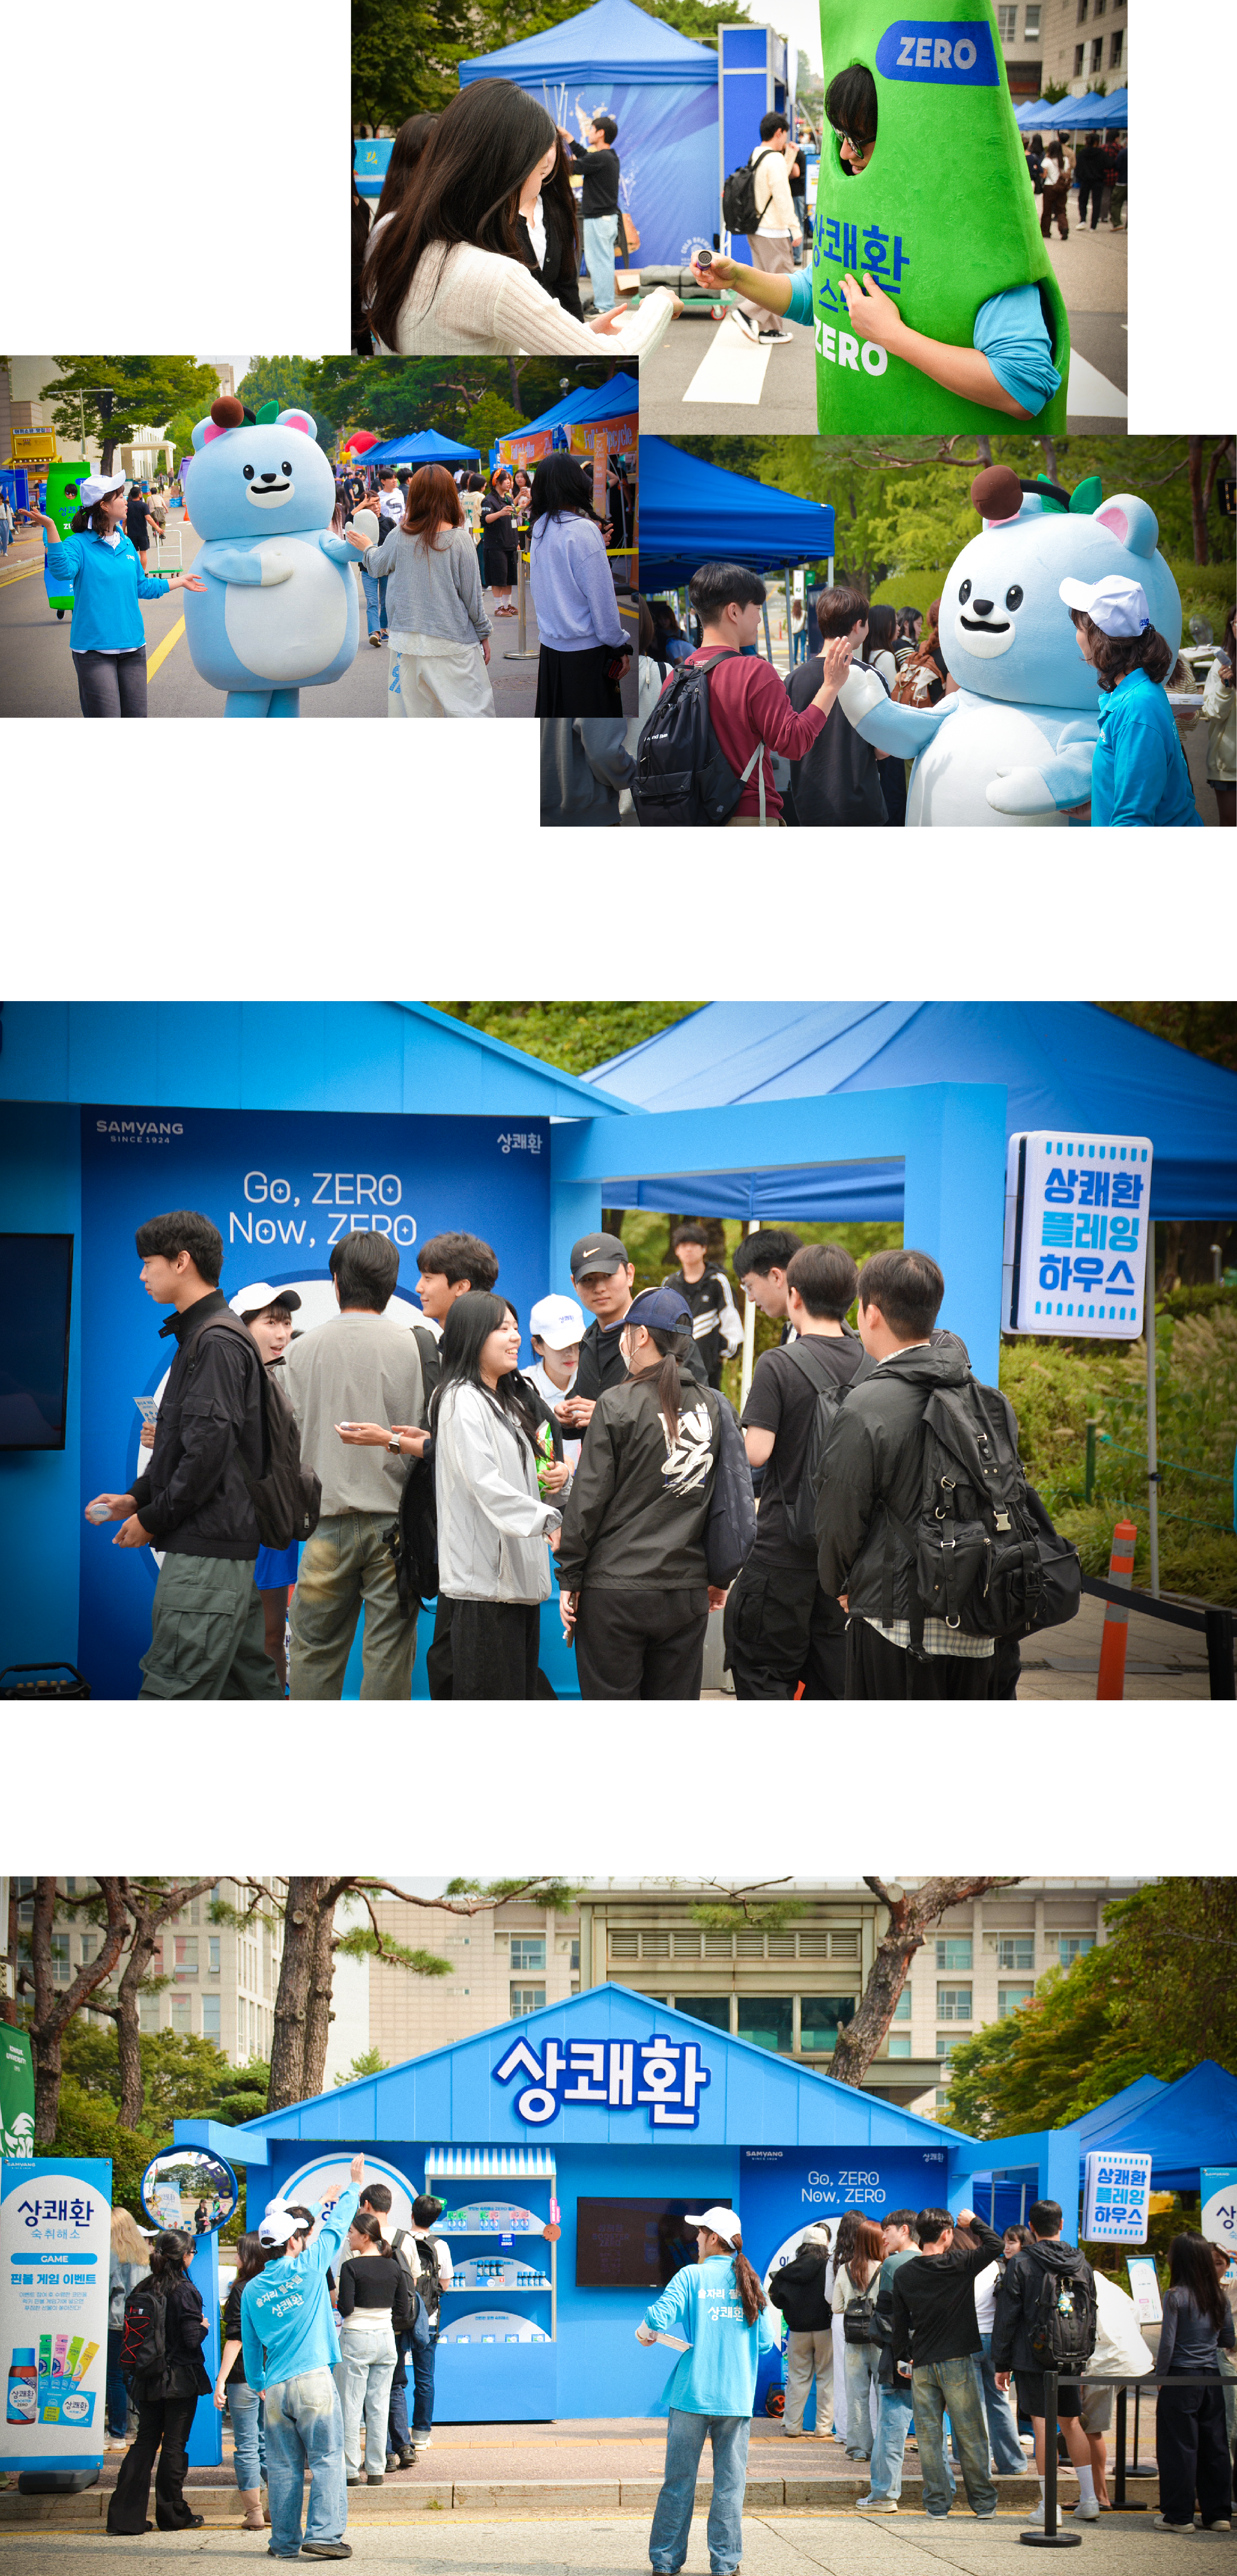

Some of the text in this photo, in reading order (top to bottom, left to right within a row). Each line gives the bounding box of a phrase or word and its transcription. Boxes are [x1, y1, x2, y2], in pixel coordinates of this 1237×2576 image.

[896, 36, 977, 70] ZERO
[814, 212, 910, 294] 상쾌환
[814, 313, 888, 376] ZERO
[583, 429, 595, 449] Fall
[96, 1120, 184, 1135] SAMYANG
[497, 1133, 543, 1154] 상쾌환
[243, 1171, 402, 1207] Go, ZERO
[1044, 1167, 1144, 1209] 상쾌환
[229, 1212, 417, 1249] Now, ZERO
[1041, 1211, 1140, 1253] 플레잉
[1039, 1253, 1136, 1296] 하우스
[496, 2038, 707, 2125] 상쾌환
[923, 2152, 944, 2162] 상쾌환
[808, 2171, 880, 2186] Go, ZERO
[1098, 2168, 1146, 2187] 상쾌환
[801, 2188, 886, 2204] Now, ZERO
[1096, 2187, 1145, 2206] 플레잉
[17, 2198, 94, 2227] 상쾌환
[1095, 2206, 1142, 2225] 하우스
[1216, 2205, 1237, 2230] 상
[31, 2229, 81, 2240] 숙취해소
[11, 2274, 96, 2284] 핀볼 게임 이벤트
[256, 2288, 278, 2308] 술자리
[698, 2288, 725, 2299] 술자리
[272, 2293, 305, 2317] 상쾌환
[708, 2306, 744, 2322] 상쾌환
[12, 2390, 34, 2399] 상쾌환
[65, 2402, 88, 2411] 상쾌환
